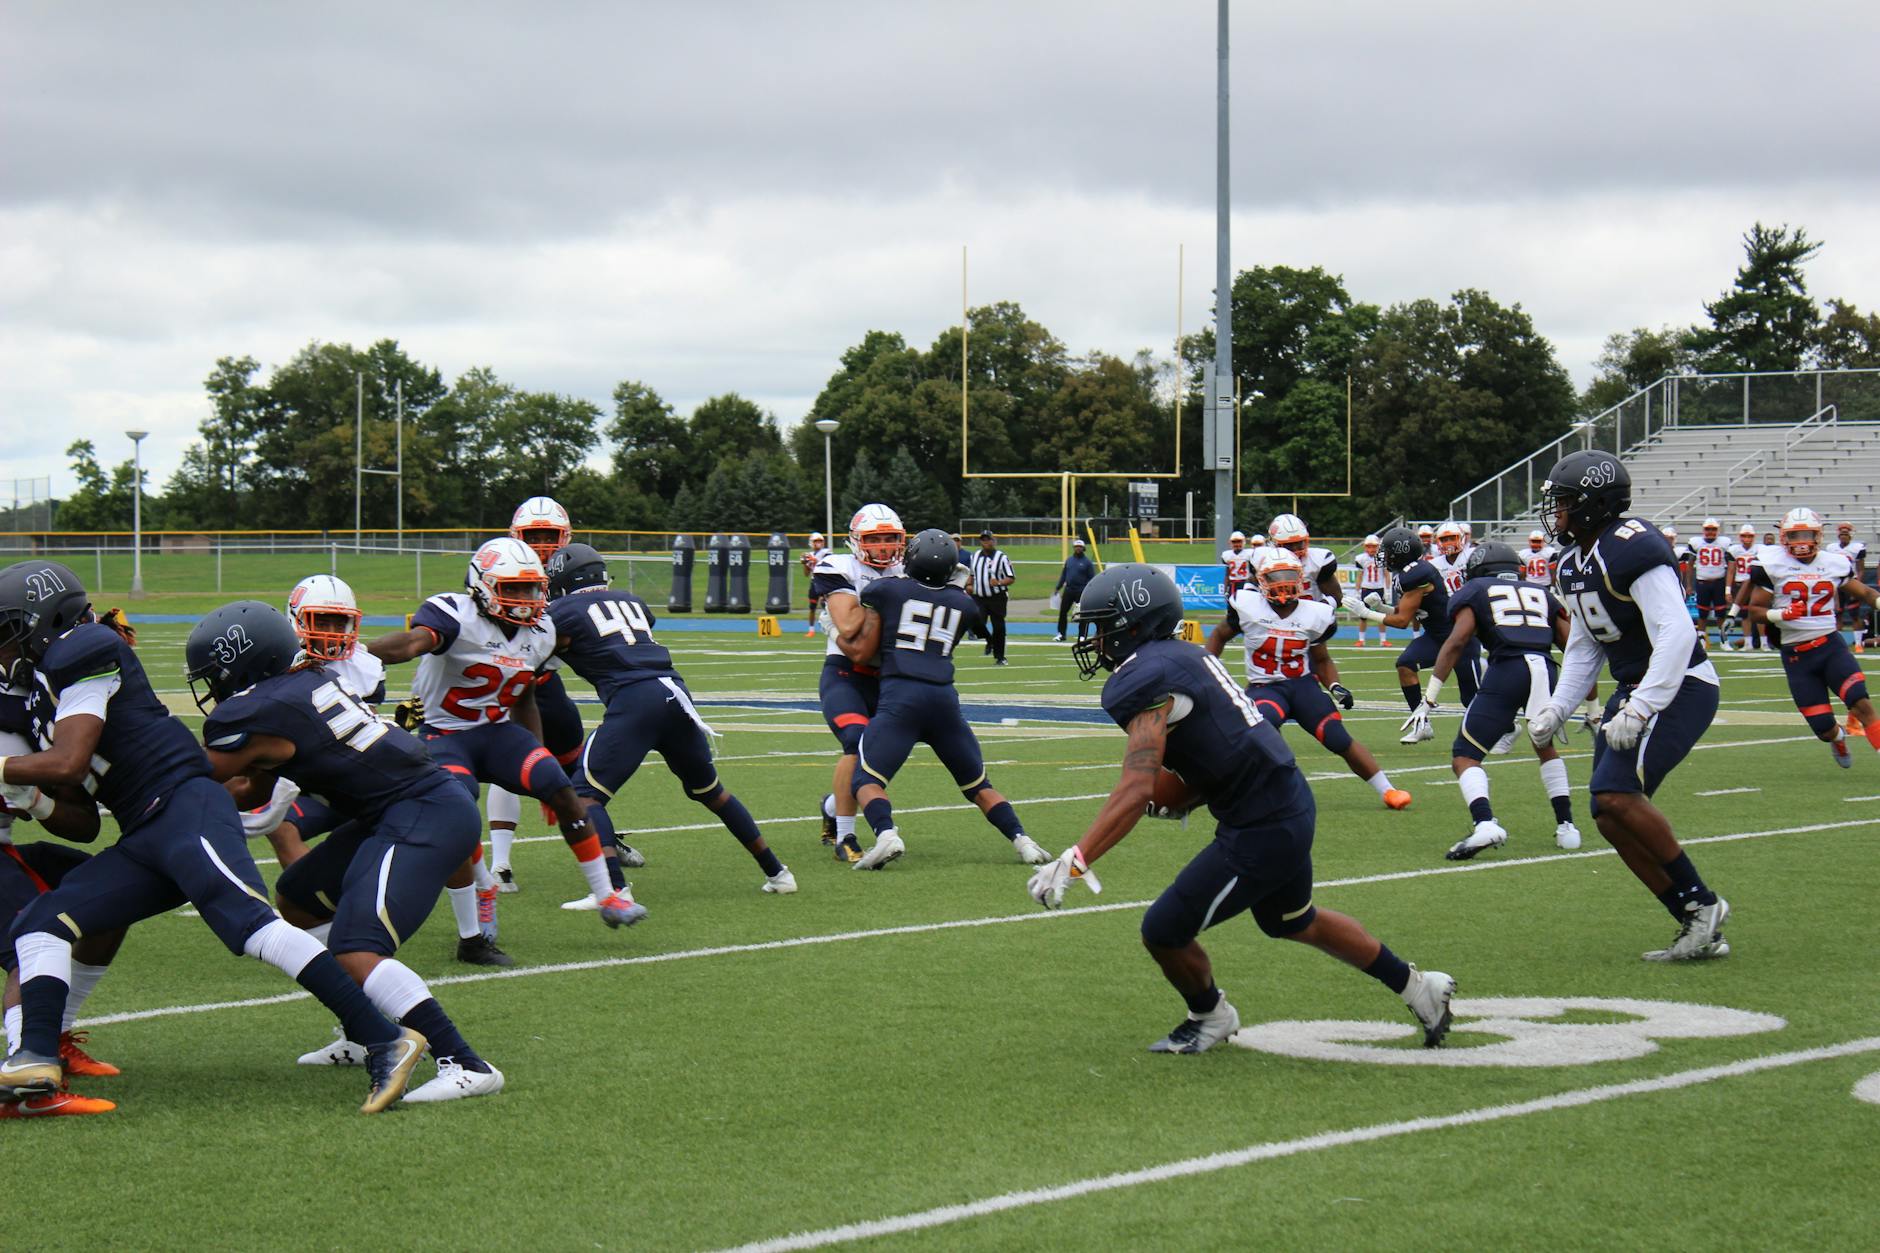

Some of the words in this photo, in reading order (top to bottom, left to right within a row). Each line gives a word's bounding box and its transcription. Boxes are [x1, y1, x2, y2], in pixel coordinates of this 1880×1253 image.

[1587, 461, 1615, 488] 89
[1393, 540, 1411, 554] 26
[1699, 548, 1723, 567] 60
[769, 555, 785, 567] 64
[1227, 561, 1249, 578] 24
[1366, 565, 1380, 583] 11
[1528, 559, 1547, 578] 46
[26, 567, 67, 602] 21
[1117, 579, 1151, 612] 16
[1487, 585, 1552, 628] 29
[1782, 581, 1835, 617] 32
[587, 600, 659, 646] 44
[761, 618, 772, 636] 20
[895, 599, 962, 656] 54
[1182, 622, 1194, 641] 30
[212, 624, 254, 664] 32
[1251, 636, 1310, 679] 45
